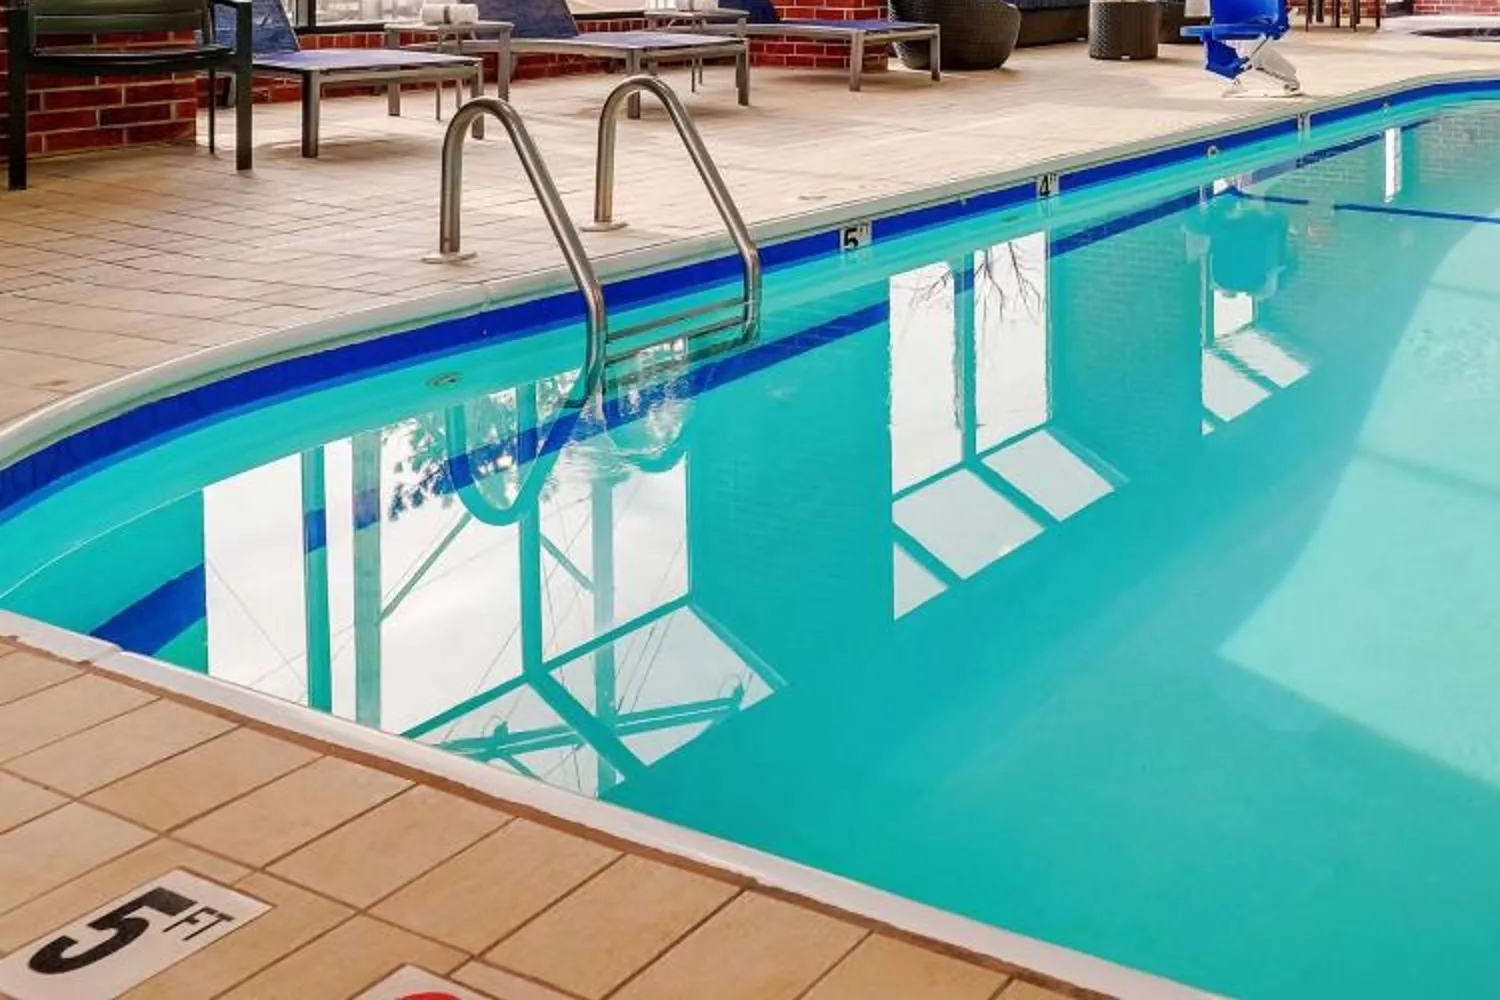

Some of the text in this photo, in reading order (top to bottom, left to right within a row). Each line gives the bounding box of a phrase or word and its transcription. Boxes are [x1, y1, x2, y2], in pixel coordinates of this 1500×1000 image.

[1039, 174, 1050, 196] 4
[843, 226, 859, 249] 5
[28, 886, 235, 975] 5 FT
